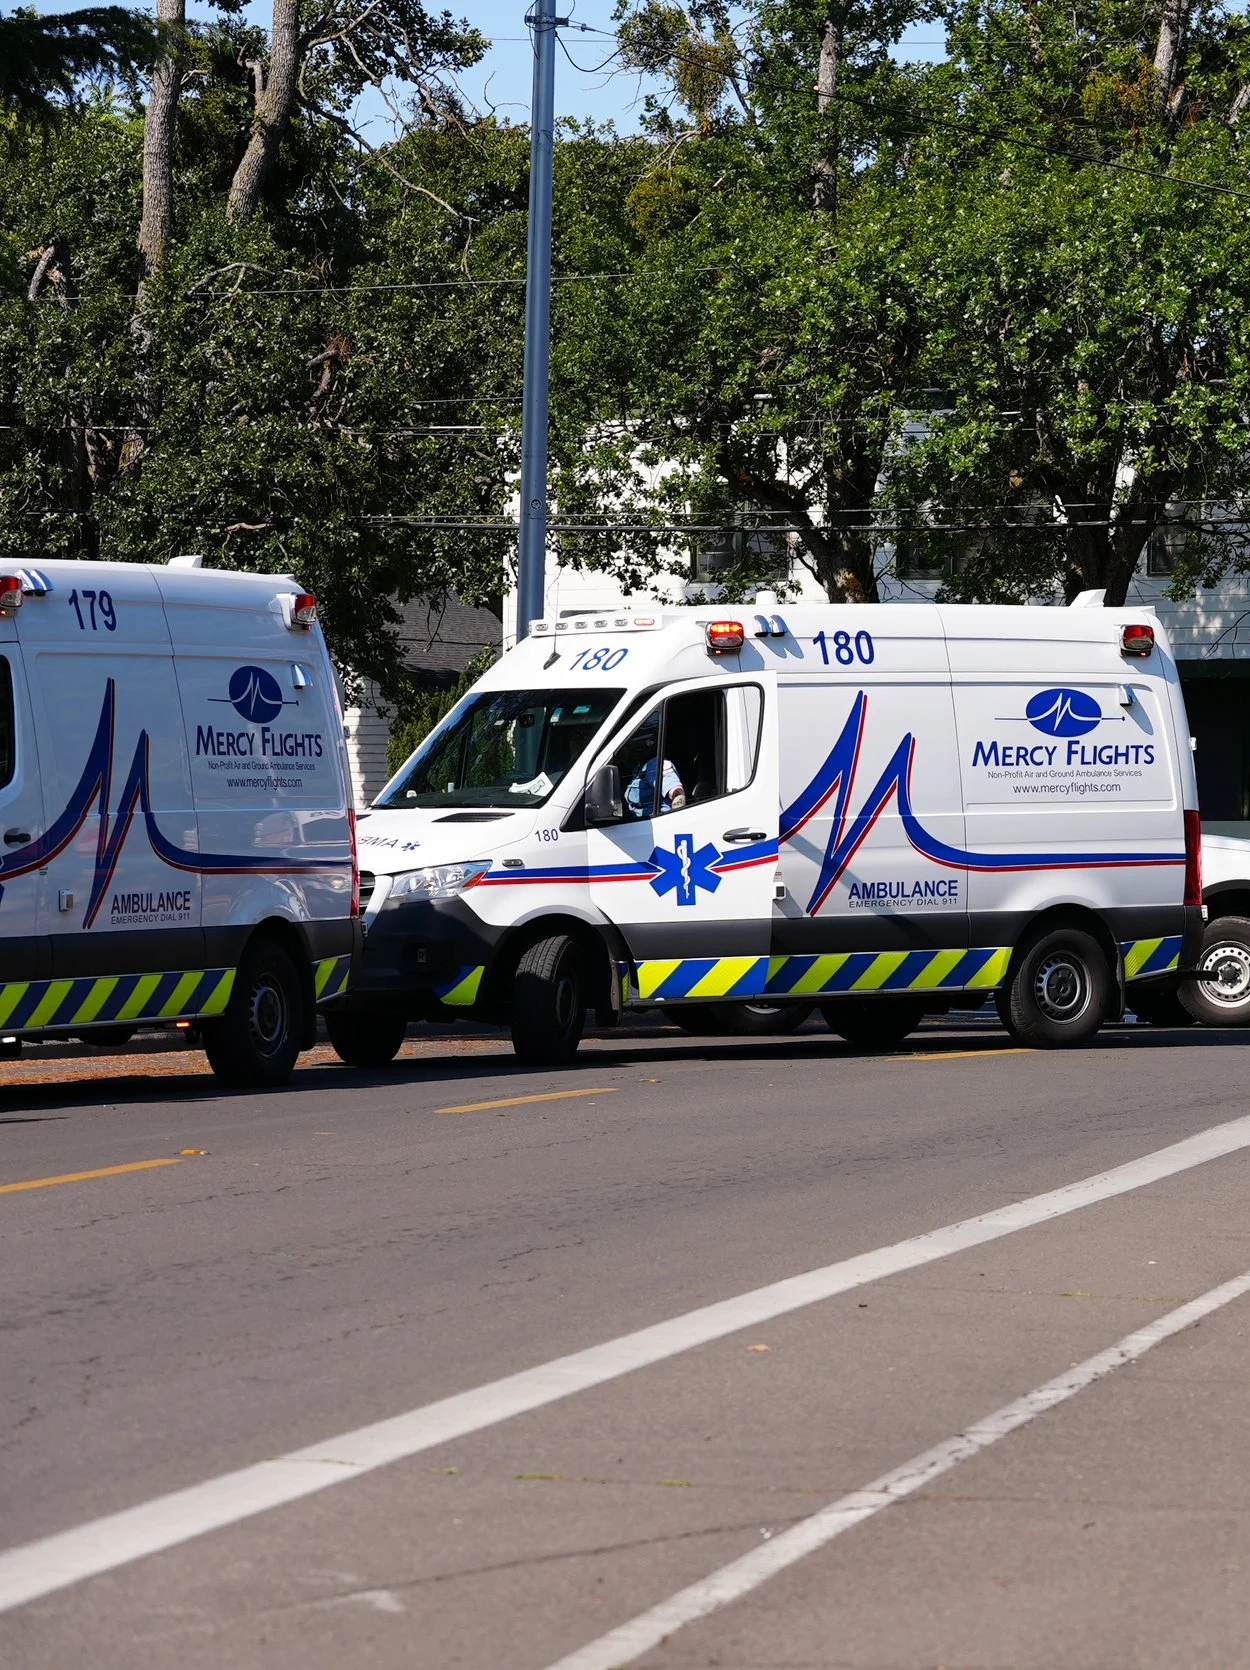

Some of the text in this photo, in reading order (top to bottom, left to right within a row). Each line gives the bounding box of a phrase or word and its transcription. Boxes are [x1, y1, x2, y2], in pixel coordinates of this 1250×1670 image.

[68, 588, 117, 632] 179
[812, 630, 875, 665] 180
[569, 647, 629, 671] 180
[196, 725, 323, 757] MERCY FLIGHTS
[972, 740, 1155, 766] MERCY FLIGHTS
[208, 761, 234, 770] Non-Profit
[242, 761, 251, 770] and
[252, 761, 269, 770] Ground
[270, 761, 295, 770] Ambulance
[296, 762, 315, 770] Services
[988, 771, 1023, 779] Non-Profit
[1035, 770, 1048, 778] and
[1049, 770, 1074, 778] Ground
[1076, 769, 1112, 778] Ambulance
[1113, 769, 1142, 777] Services
[227, 776, 302, 790] www.mercyflights.com
[1013, 782, 1121, 795] www.mercyflights.com
[535, 828, 559, 842] 180
[848, 880, 958, 900] AMBULANCE
[111, 890, 191, 915] AMBULANCE
[849, 897, 957, 908] EMERGENCY DIAL 911
[111, 912, 190, 925] EMERGENCY DIAL 911
